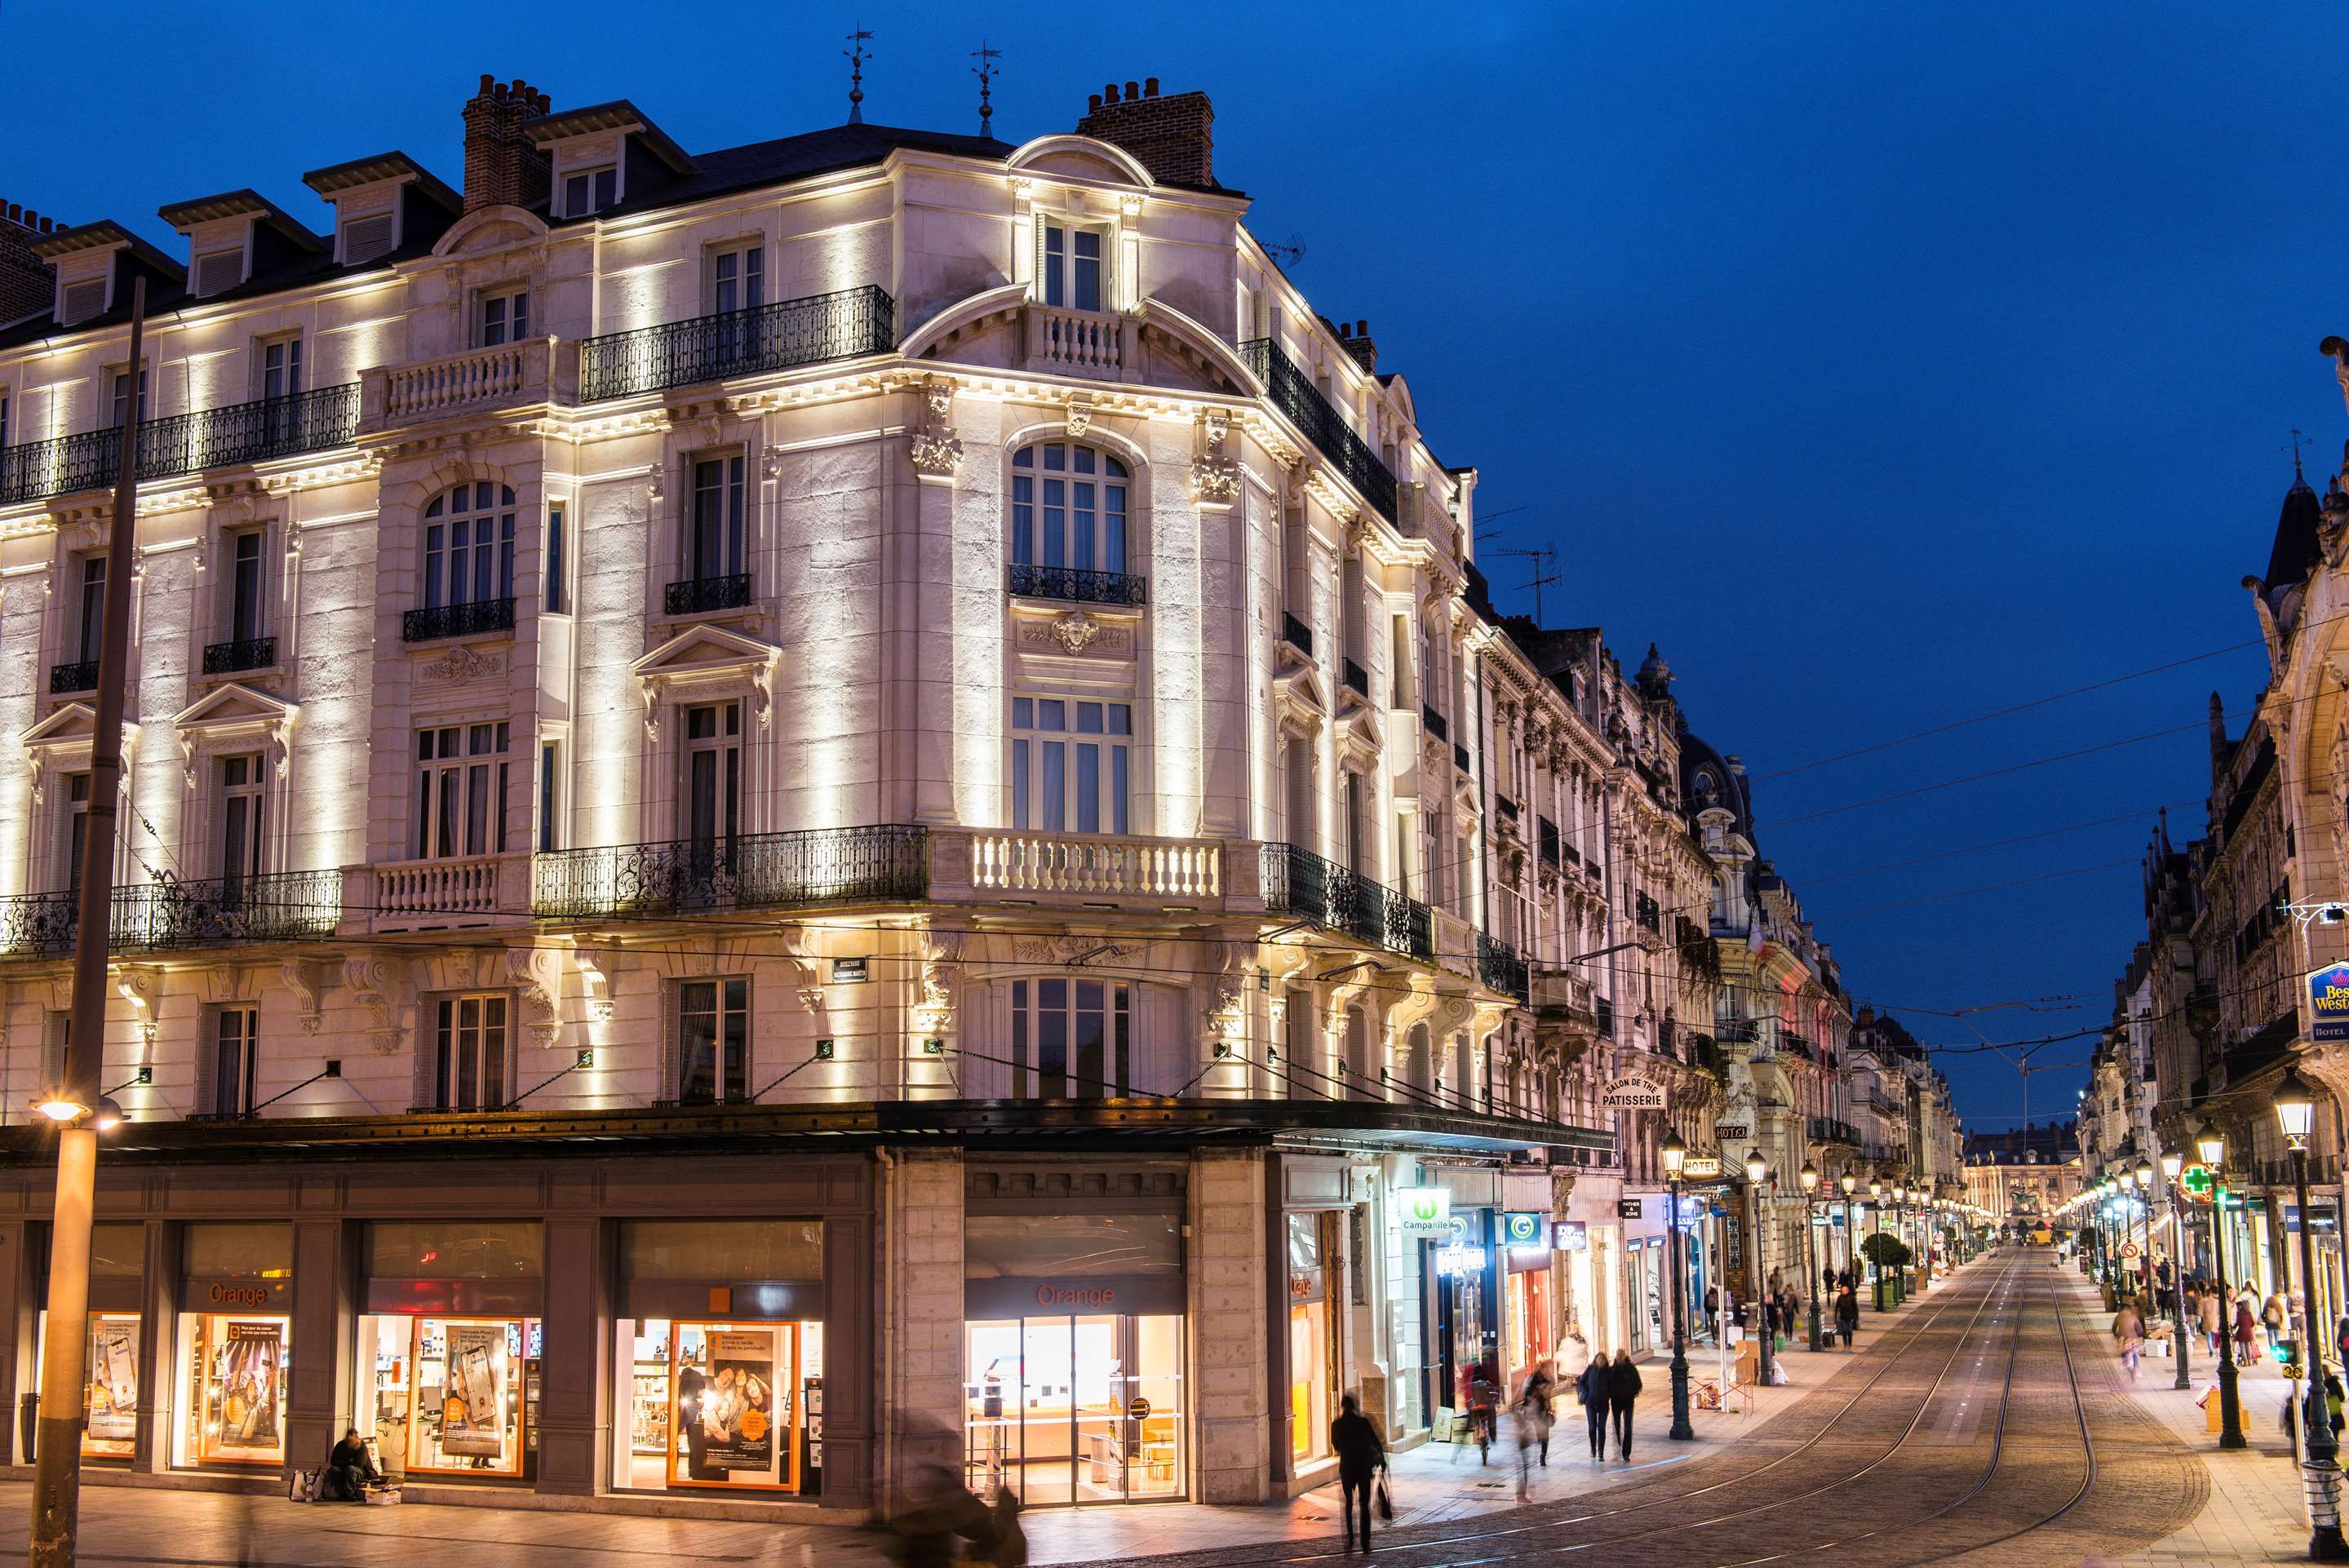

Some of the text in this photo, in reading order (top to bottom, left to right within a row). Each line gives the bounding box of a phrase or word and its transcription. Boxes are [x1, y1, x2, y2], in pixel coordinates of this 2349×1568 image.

[2325, 986, 2349, 999] Bes
[2315, 998, 2349, 1011] West
[2316, 1028, 2347, 1036] HOTEL
[1606, 1078, 1658, 1094] SALON DE THE
[1602, 1095, 1661, 1105] PATISSERIE
[1717, 1127, 1746, 1138] HOTEL
[1685, 1161, 1717, 1172] HOTEL
[1403, 1220, 1448, 1231] Campanile
[1292, 1278, 1312, 1295] Orange
[209, 1282, 267, 1307] Orange
[1037, 1284, 1115, 1309] Orange
[2284, 1366, 2302, 1379] 20
